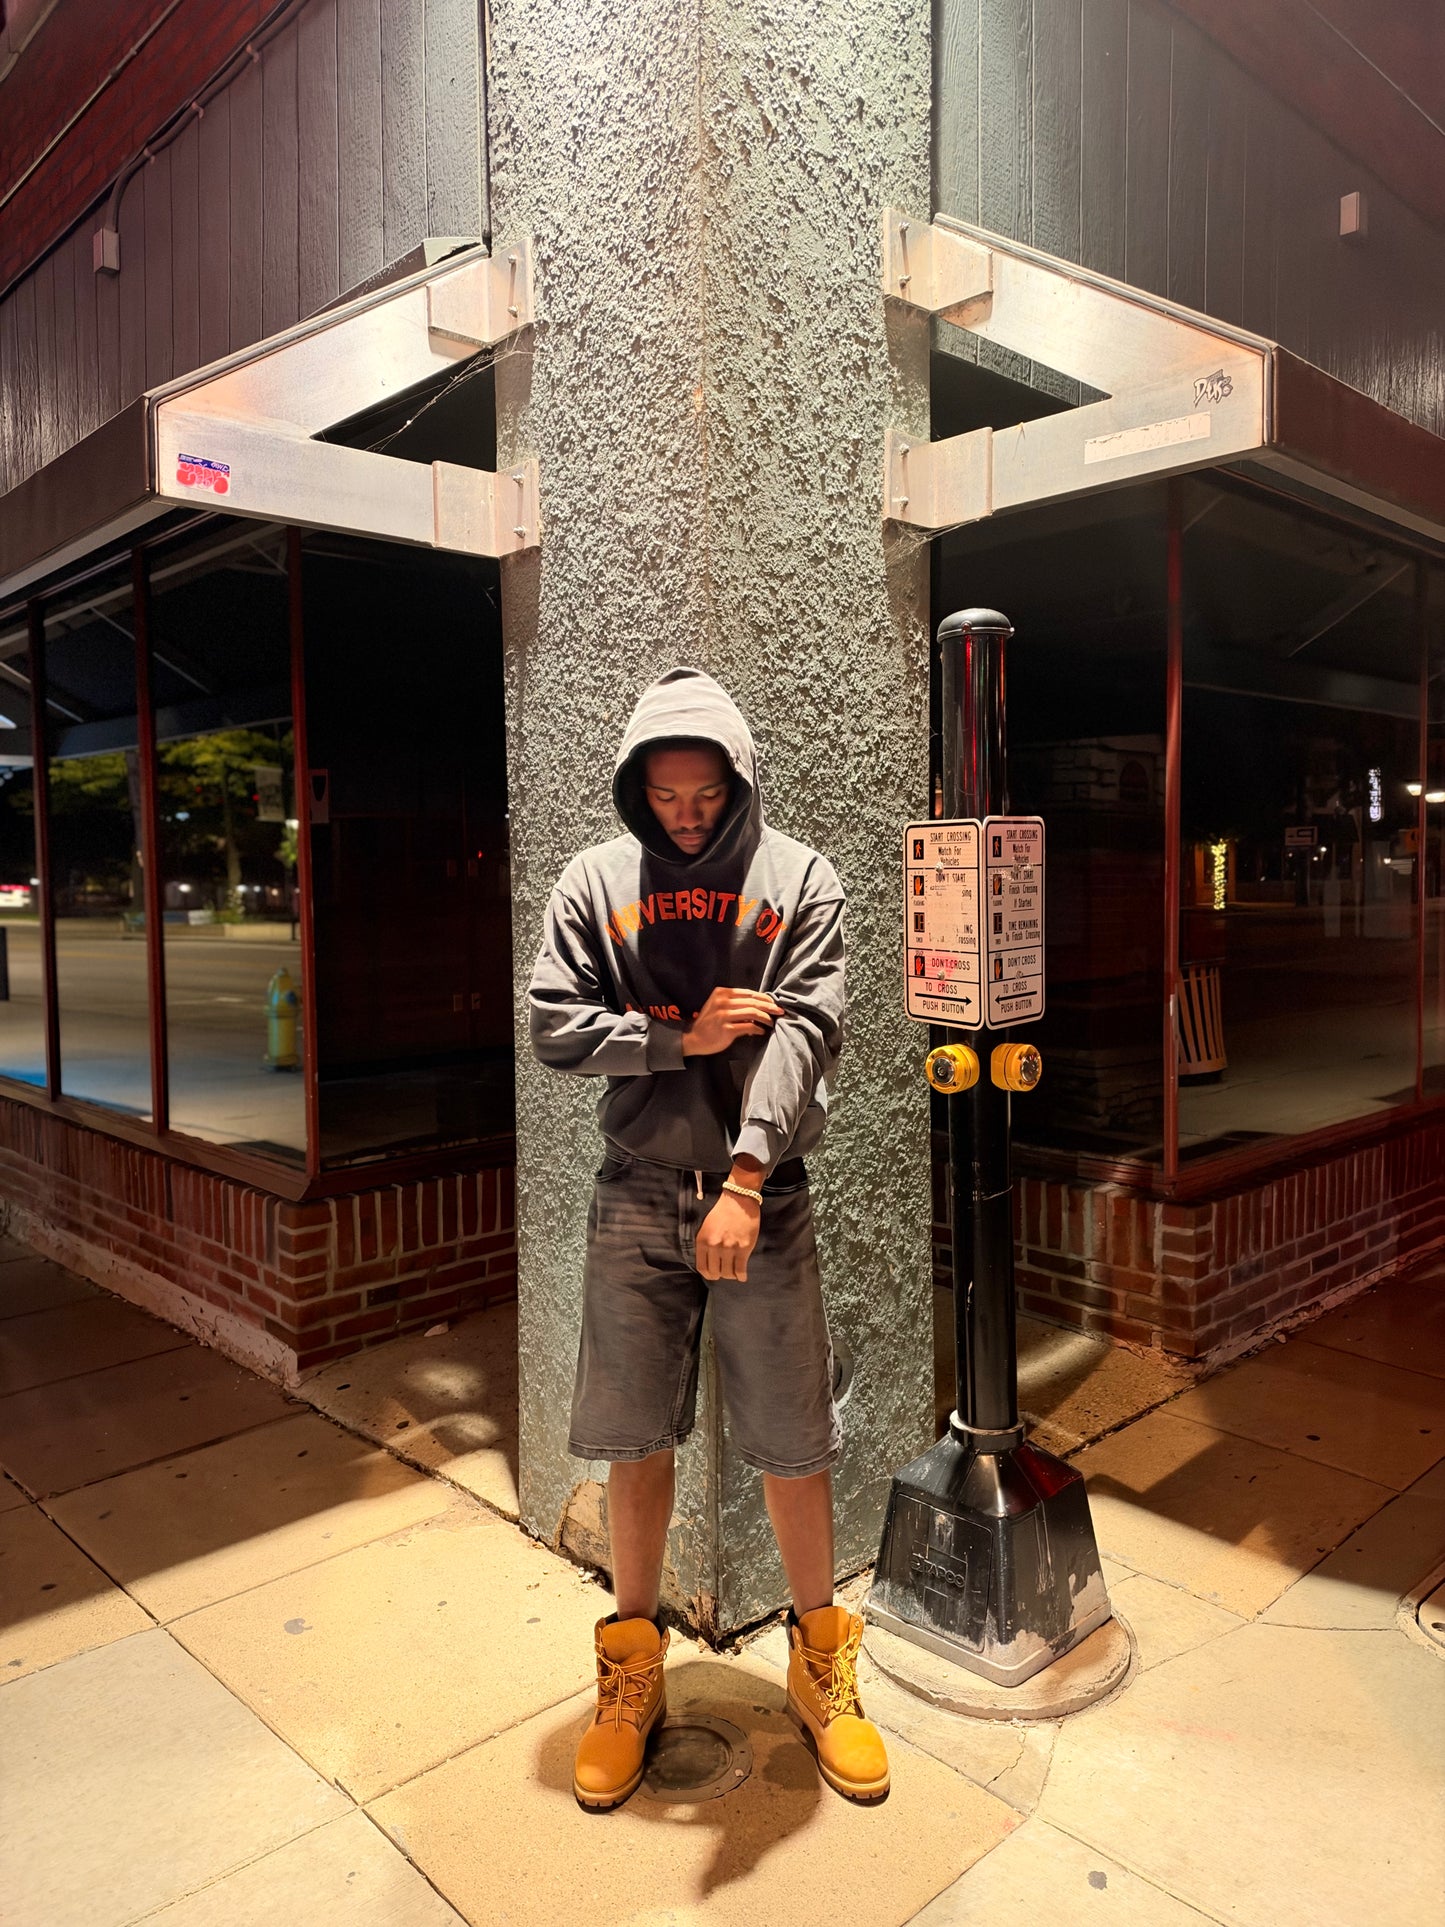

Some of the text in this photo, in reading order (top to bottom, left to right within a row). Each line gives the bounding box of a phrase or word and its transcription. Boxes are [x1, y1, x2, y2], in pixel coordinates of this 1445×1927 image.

[930, 831, 972, 842] START CROSSING
[1006, 829, 1038, 839] START CROSSING
[938, 846, 962, 856] Watch For
[952, 873, 966, 882] START
[1024, 870, 1034, 880] START
[1008, 918, 1038, 931] TIME REMAINING
[950, 959, 970, 971] CROSS
[1022, 954, 1036, 966] CROSS
[925, 982, 958, 995] TO CROSS
[1002, 981, 1028, 994] TO CROSS
[922, 1000, 964, 1015] PUSH BUTTON
[1000, 998, 1032, 1014] PUSH BUTTON
